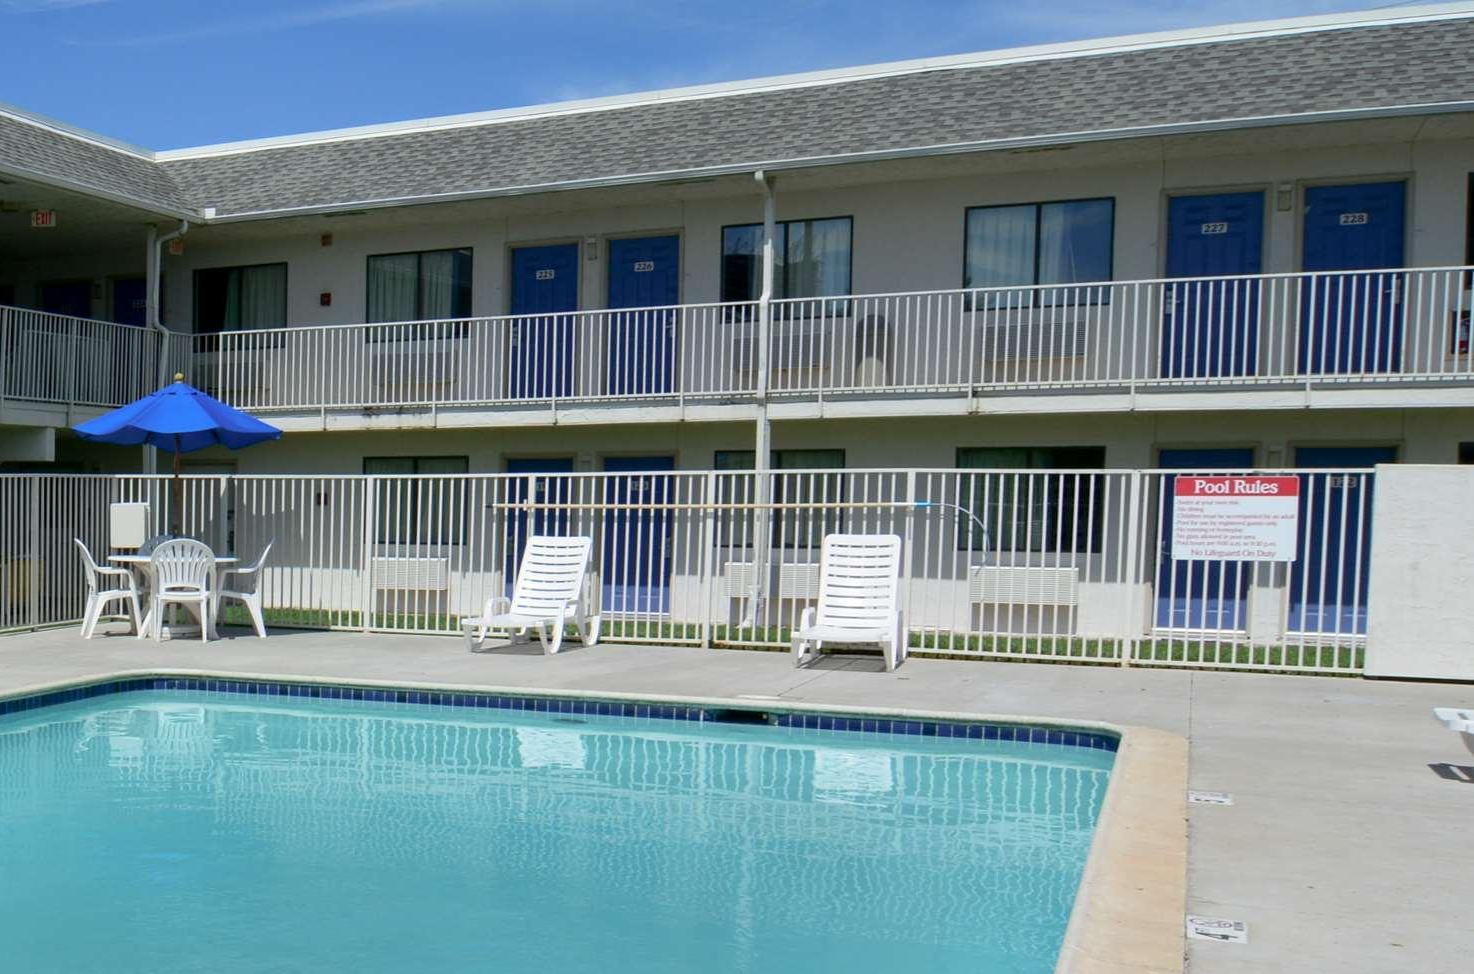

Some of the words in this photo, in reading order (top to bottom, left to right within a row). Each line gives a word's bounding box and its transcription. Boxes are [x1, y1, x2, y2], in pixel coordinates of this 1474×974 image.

[36, 211, 52, 225] EXIT
[1341, 214, 1365, 224] 228
[1204, 224, 1225, 233] 227
[1194, 479, 1230, 494] Pool
[1234, 479, 1279, 494] Rules
[1242, 549, 1255, 557] On
[1256, 550, 1278, 558] Duty
